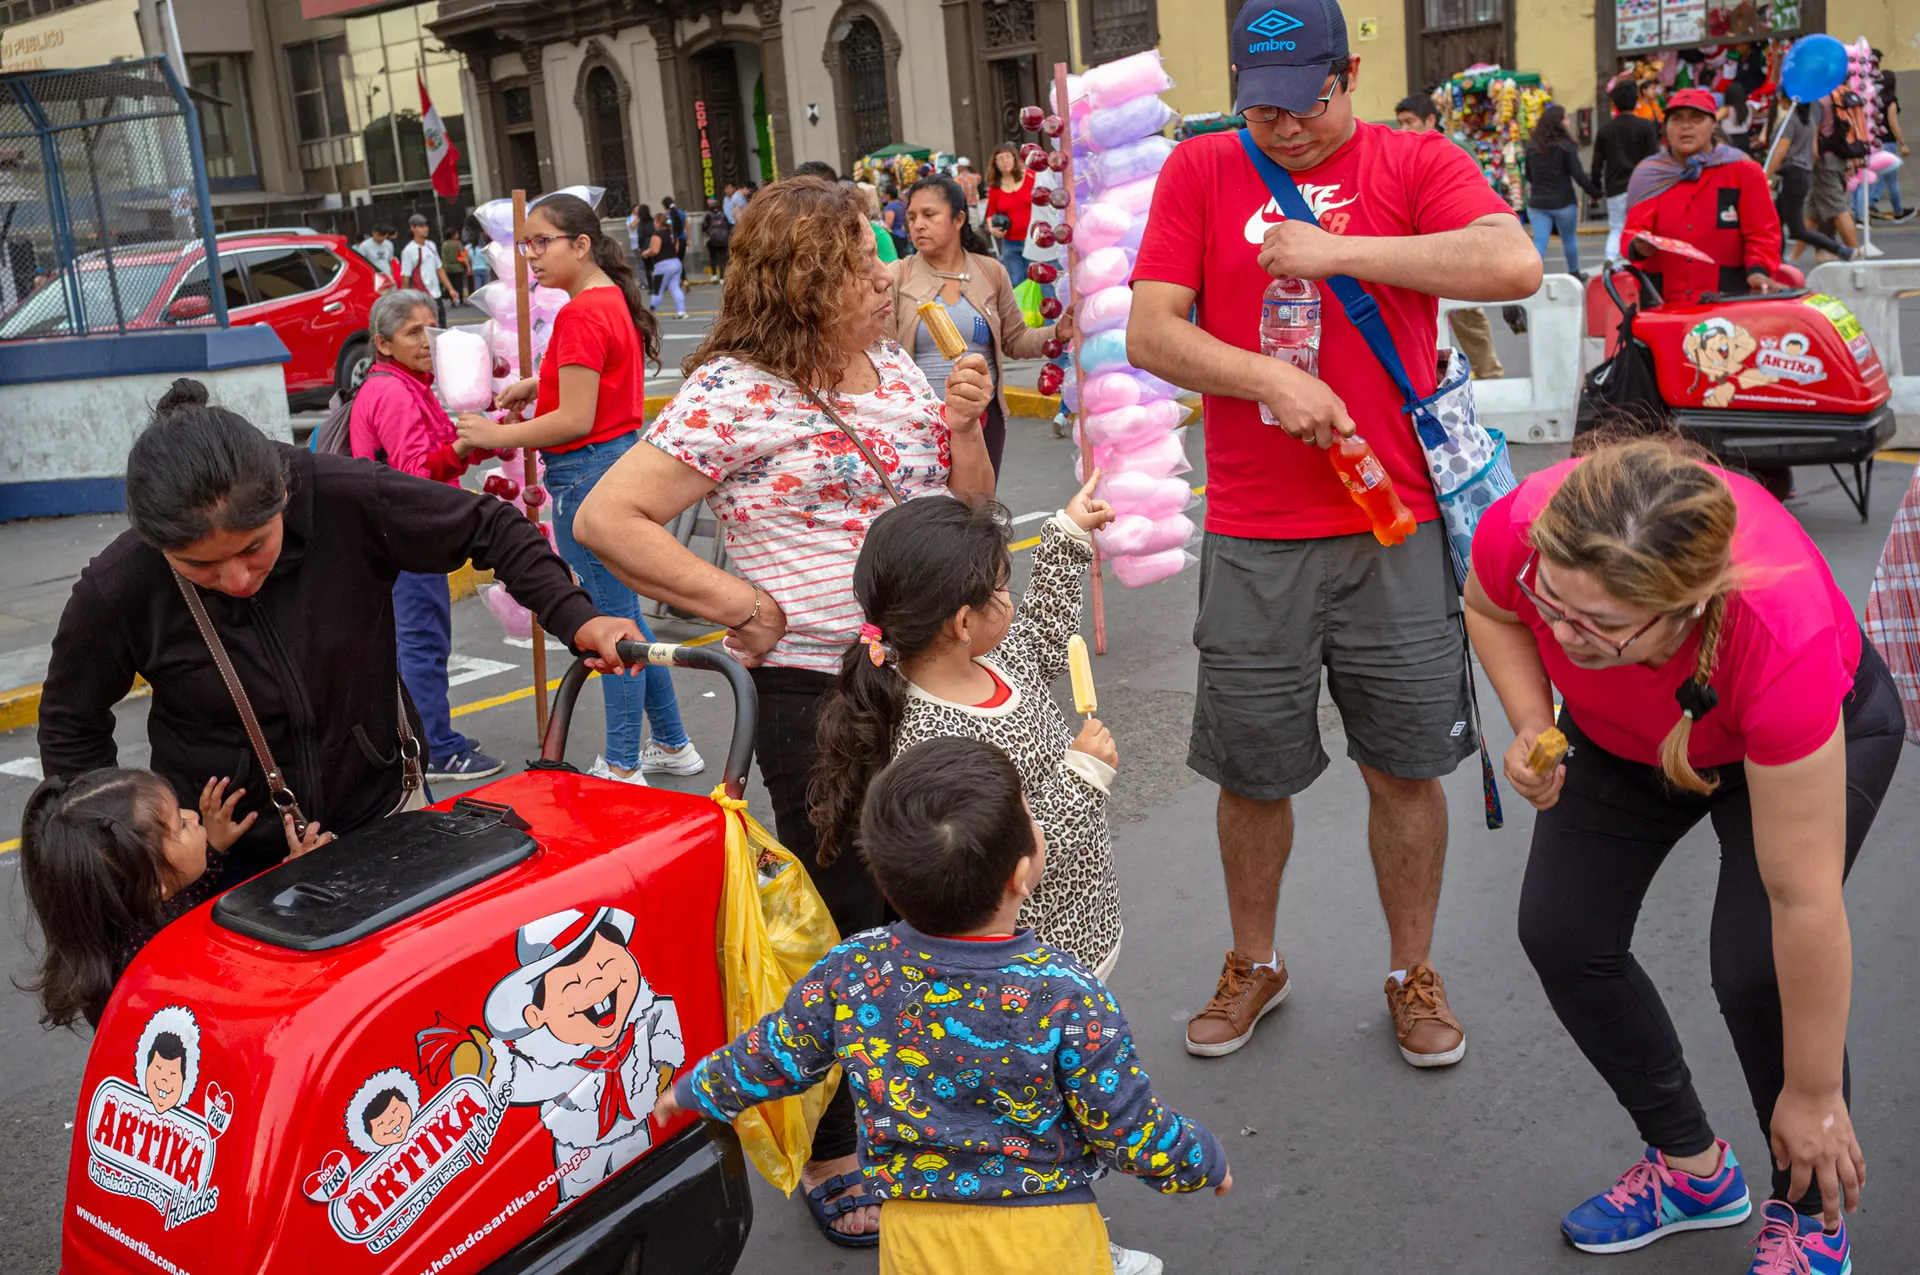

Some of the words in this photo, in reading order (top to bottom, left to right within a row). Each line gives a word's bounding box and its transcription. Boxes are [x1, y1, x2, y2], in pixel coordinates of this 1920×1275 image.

[12, 28, 65, 56] PUBLICO
[1249, 39, 1296, 54] umbro
[695, 101, 711, 158] COPIAS
[1264, 184, 1342, 217] KE
[1320, 212, 1350, 235] SB
[207, 1105, 227, 1129] PERU
[461, 1081, 514, 1165] Helados
[93, 1094, 207, 1193] ARTIKA
[345, 1089, 488, 1233] ARTIKA
[89, 1158, 100, 1182] Un
[100, 1168, 130, 1194] helado
[129, 1181, 138, 1195] a
[138, 1180, 149, 1198] tu
[148, 1182, 167, 1215] lado!
[317, 1164, 334, 1185] 100%
[322, 1165, 347, 1198] PERU
[165, 1178, 218, 1230] Helados
[368, 1235, 391, 1252] Un
[386, 1200, 425, 1241] helado
[421, 1191, 433, 1204] a
[427, 1179, 443, 1196] tu
[437, 1154, 470, 1186] lado!
